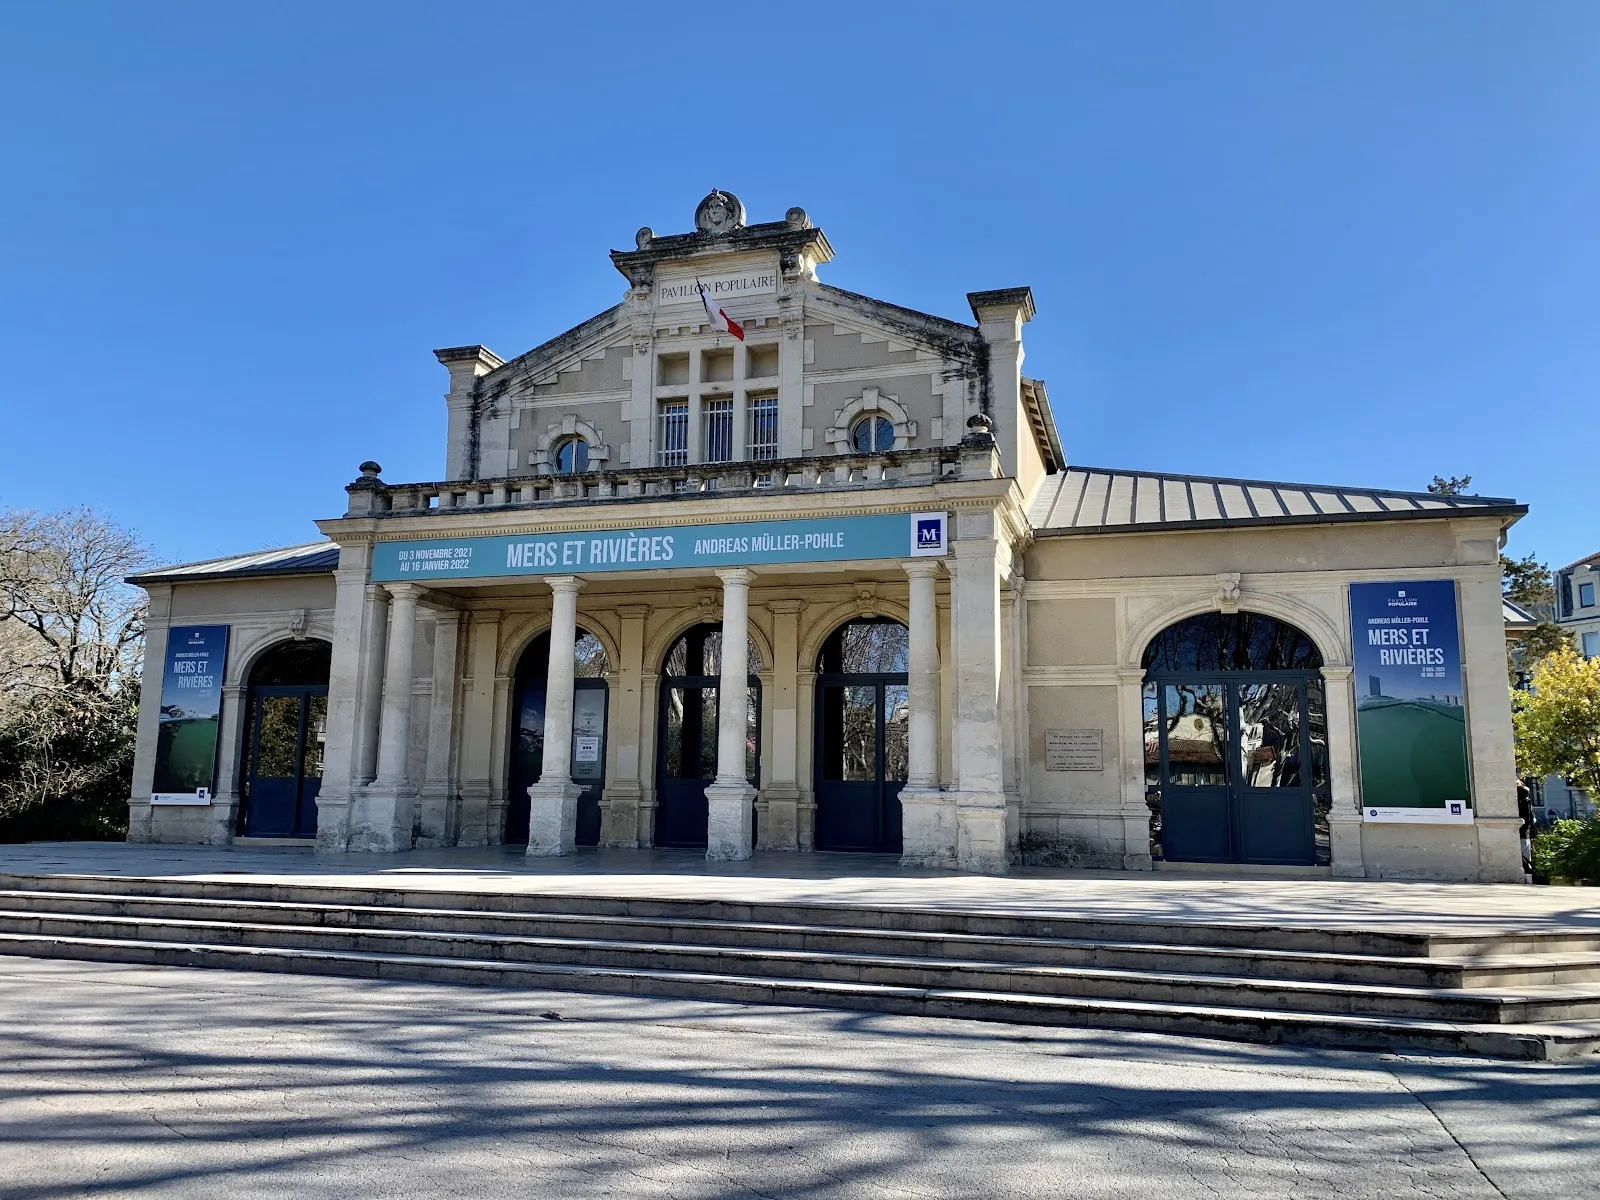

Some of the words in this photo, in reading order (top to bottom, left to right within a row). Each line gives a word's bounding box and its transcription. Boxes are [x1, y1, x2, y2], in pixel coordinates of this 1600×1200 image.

[661, 282, 711, 298] PAVILLON
[715, 275, 776, 292] POPULAIRE
[921, 528, 938, 541] M
[507, 541, 557, 568] MERS
[562, 540, 586, 565] ET
[590, 532, 674, 564] RIVIÈRES
[694, 537, 749, 555] ANDREAS
[752, 532, 845, 552] MÜLLER-POHLE
[398, 550, 408, 560] DU
[409, 550, 415, 559] 3
[415, 548, 453, 559] NOVEMBRE
[454, 547, 473, 558] 2021
[400, 562, 410, 572] AU
[411, 561, 420, 571] 16
[421, 560, 449, 571] JANVIER
[450, 559, 469, 570] 2022
[1368, 629, 1408, 646] MERS
[1412, 628, 1429, 645] ET
[1380, 644, 1445, 666] RIVIÈRES
[173, 661, 195, 674] MERS
[197, 661, 208, 673] ET
[177, 673, 213, 689] RIVIÈRES
